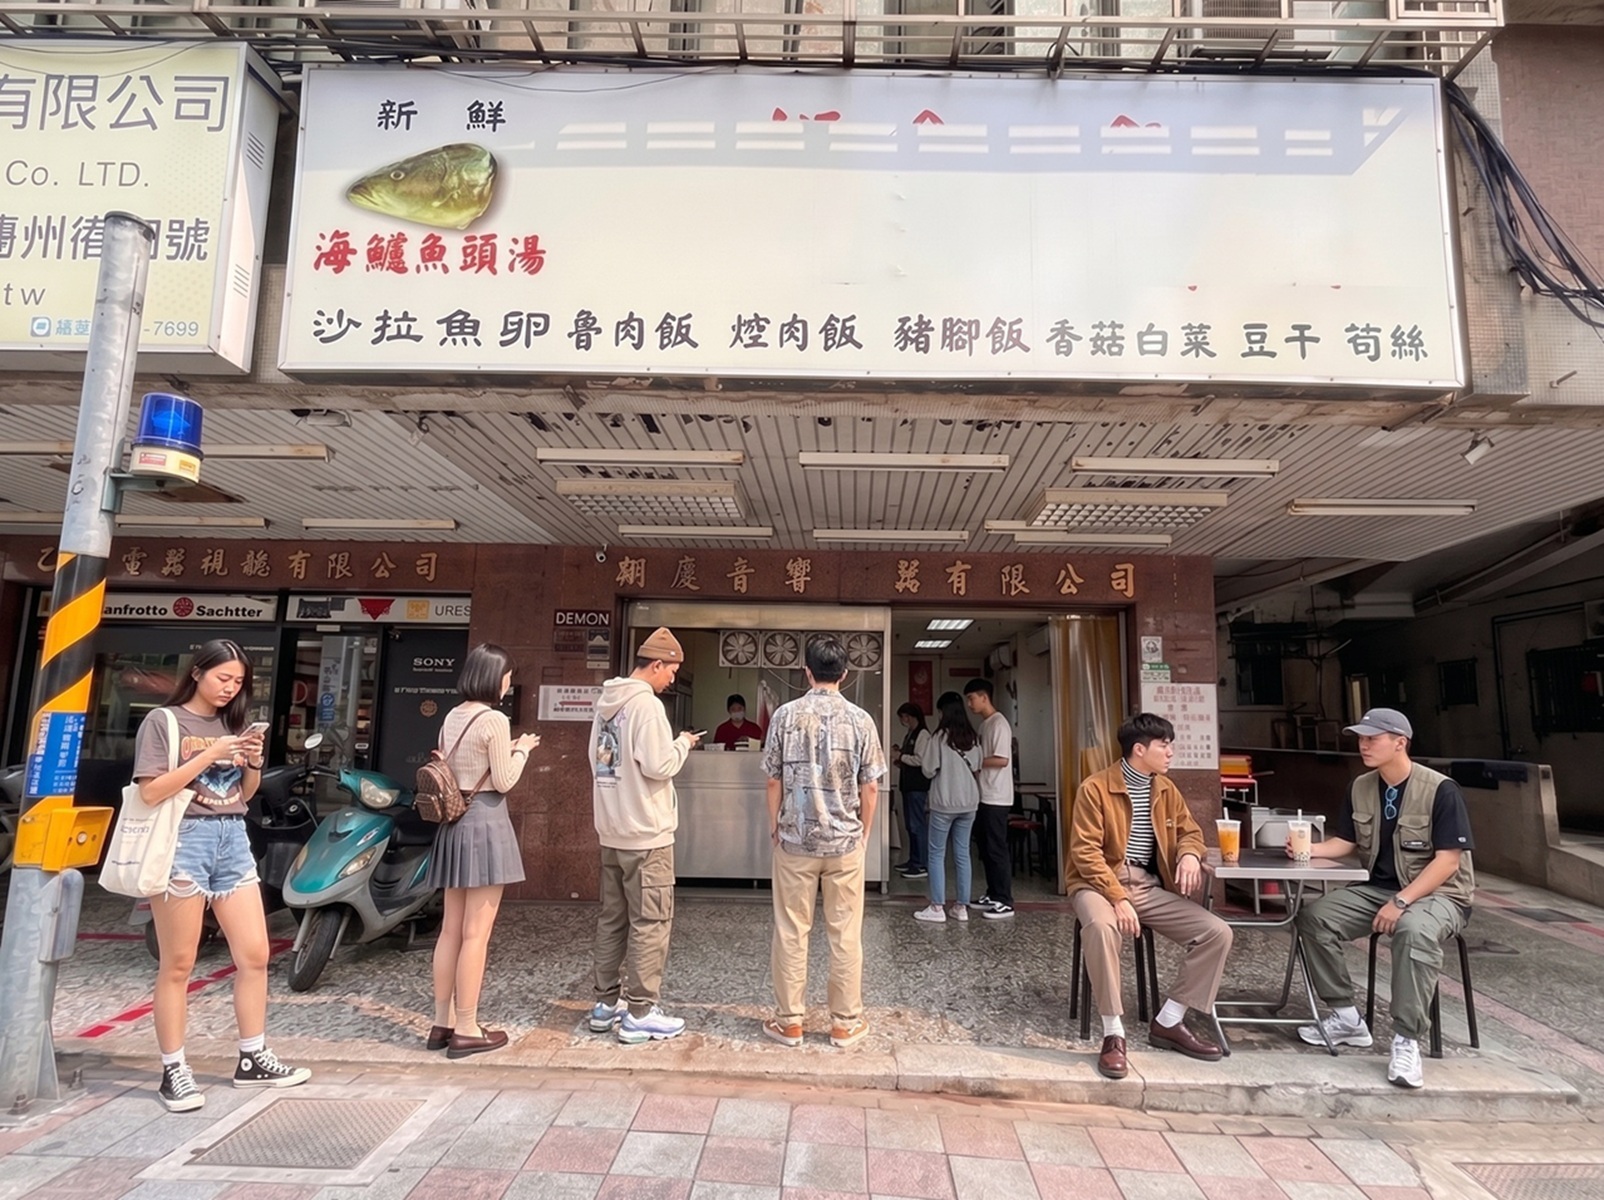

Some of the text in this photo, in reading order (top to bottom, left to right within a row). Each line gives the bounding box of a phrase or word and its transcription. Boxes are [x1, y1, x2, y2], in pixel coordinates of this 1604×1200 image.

[5, 159, 149, 187] Co. LTD.
[313, 229, 546, 276] 海鱸魚頭湯
[893, 313, 1031, 357] 豬腳飯
[1046, 318, 1217, 358] 香菇白菜
[1240, 323, 1321, 360] 豆干
[555, 611, 610, 626] DEMON
[413, 657, 455, 667] SONY
